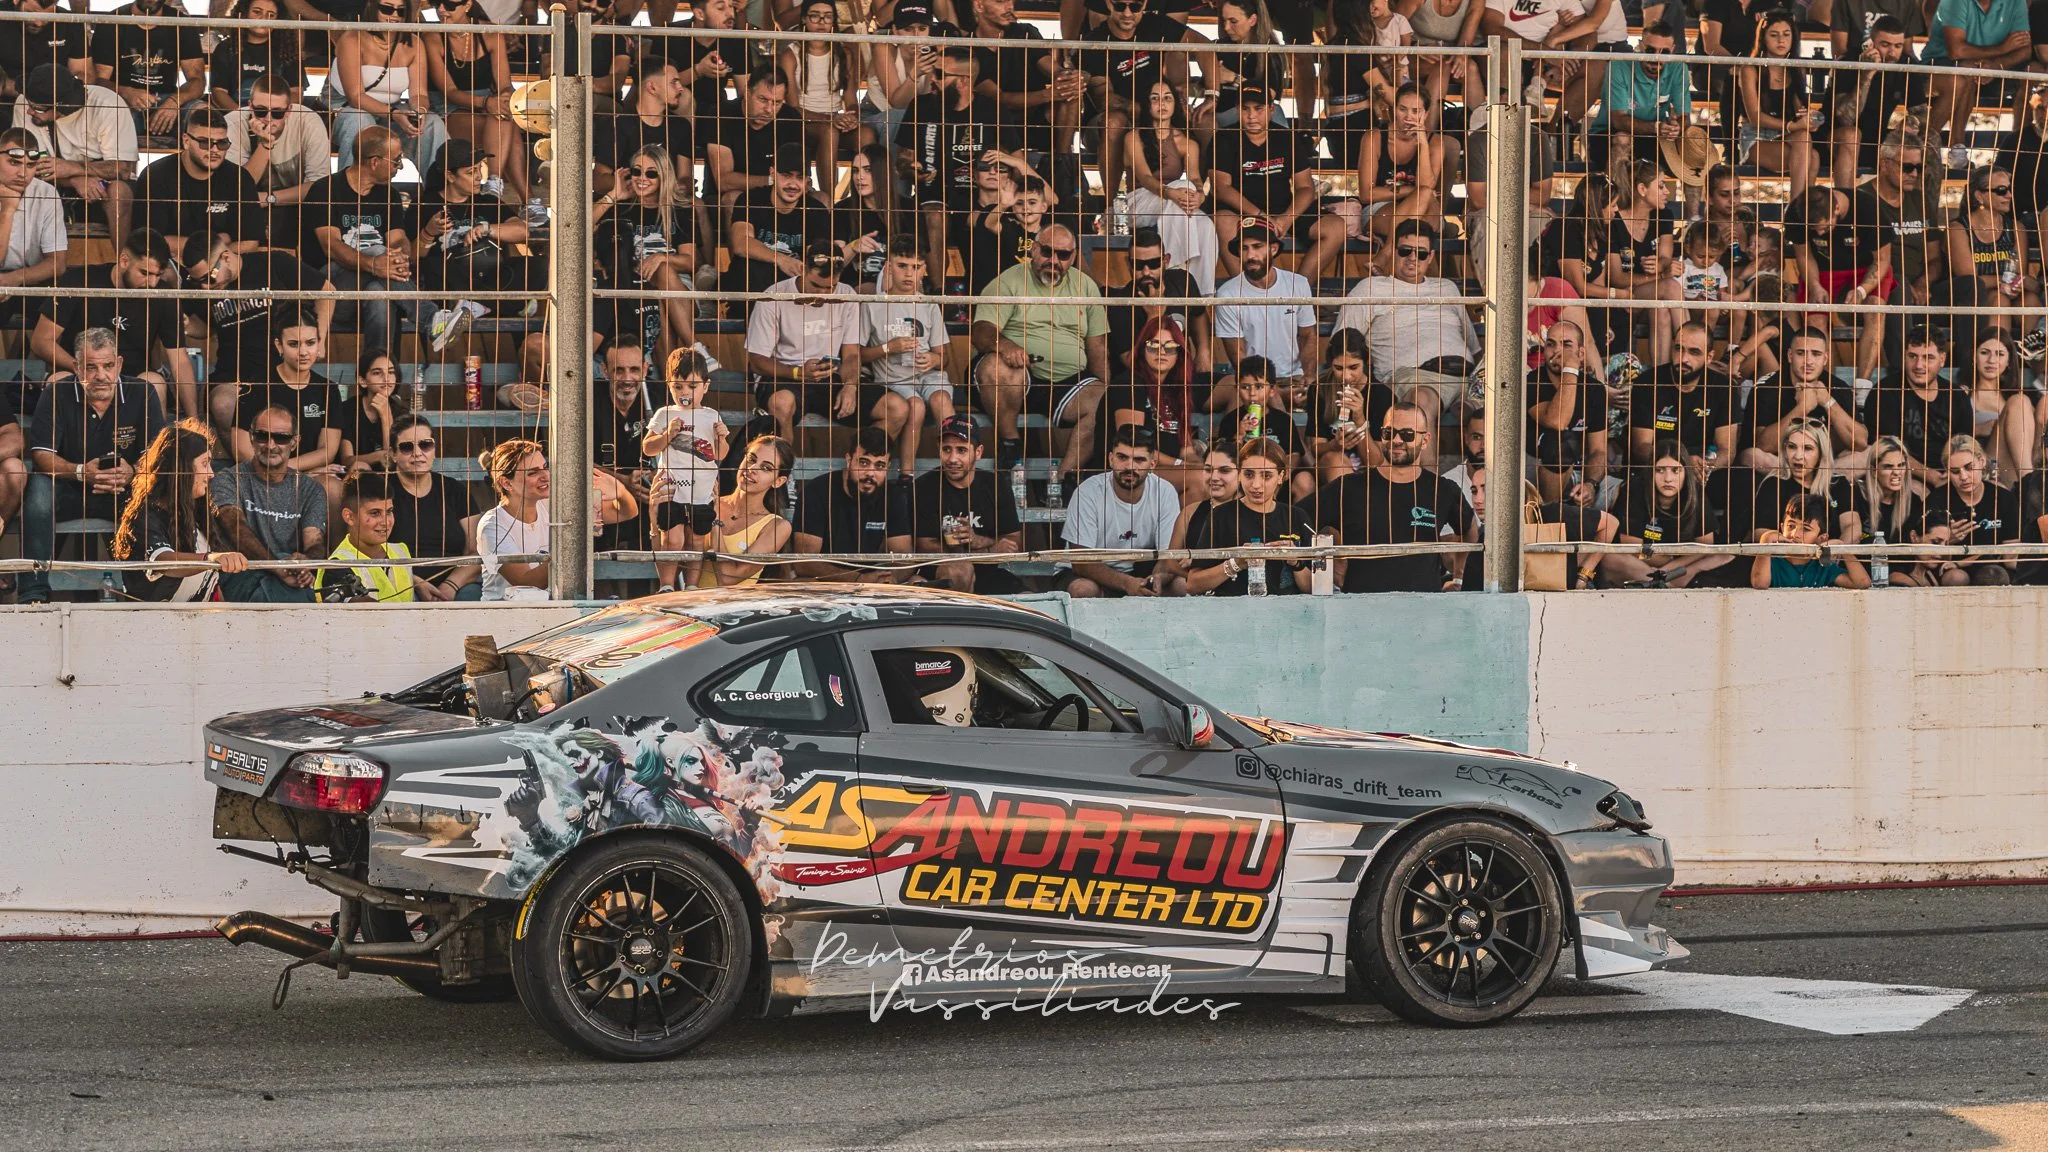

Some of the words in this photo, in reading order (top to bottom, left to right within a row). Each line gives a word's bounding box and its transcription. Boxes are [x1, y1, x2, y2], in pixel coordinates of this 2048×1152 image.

[713, 693, 726, 702] A.
[729, 692, 742, 701] C.
[745, 690, 800, 702] Georgiou
[225, 751, 268, 772] PSALTIS
[223, 768, 241, 780] AUTO
[241, 772, 265, 786] PARTS
[1264, 763, 1443, 800] @chiaras_drift_team
[867, 793, 1285, 890] ANDREOU
[795, 867, 832, 878] Tuning
[831, 865, 868, 876] Spirit
[905, 864, 997, 906] CAR
[1005, 873, 1176, 922] CENTER
[1181, 890, 1264, 929] LTD
[926, 965, 1054, 984] Asandreou
[1062, 962, 1172, 981] Rentecar
